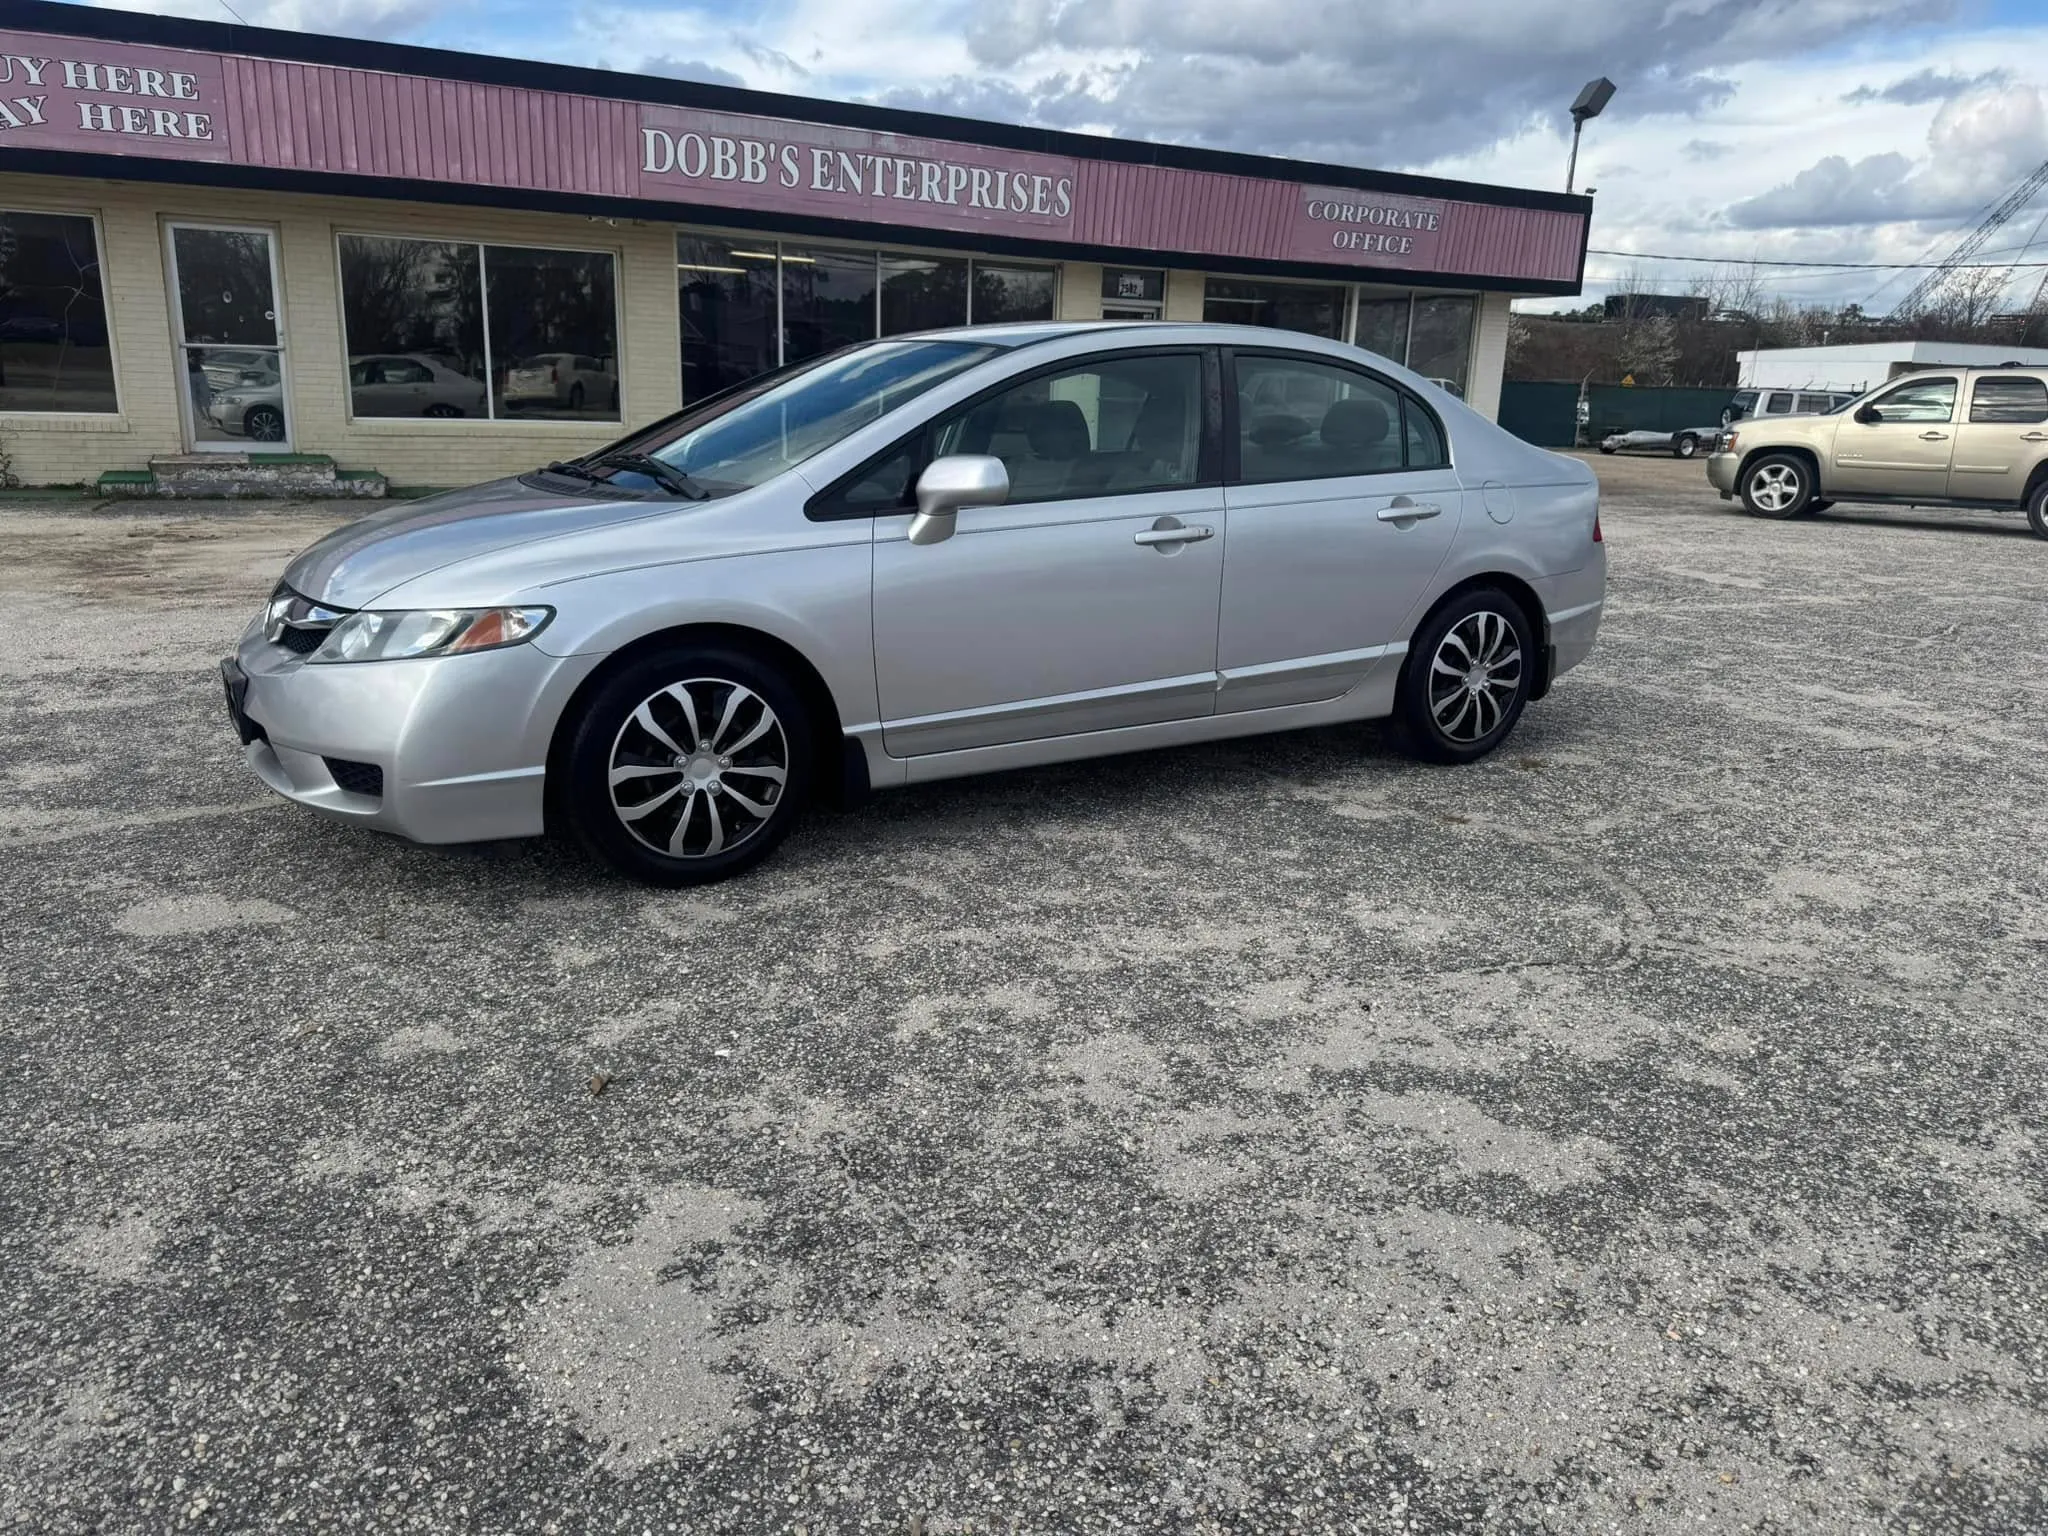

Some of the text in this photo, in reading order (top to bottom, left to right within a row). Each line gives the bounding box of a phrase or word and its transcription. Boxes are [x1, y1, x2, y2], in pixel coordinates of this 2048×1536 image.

[59, 59, 200, 101] HERE
[75, 101, 214, 141] HERE
[641, 127, 1073, 218] DOBB'S ENTERPRISES
[1307, 200, 1440, 232] CORPORATE
[1332, 230, 1413, 254] OFFICE
